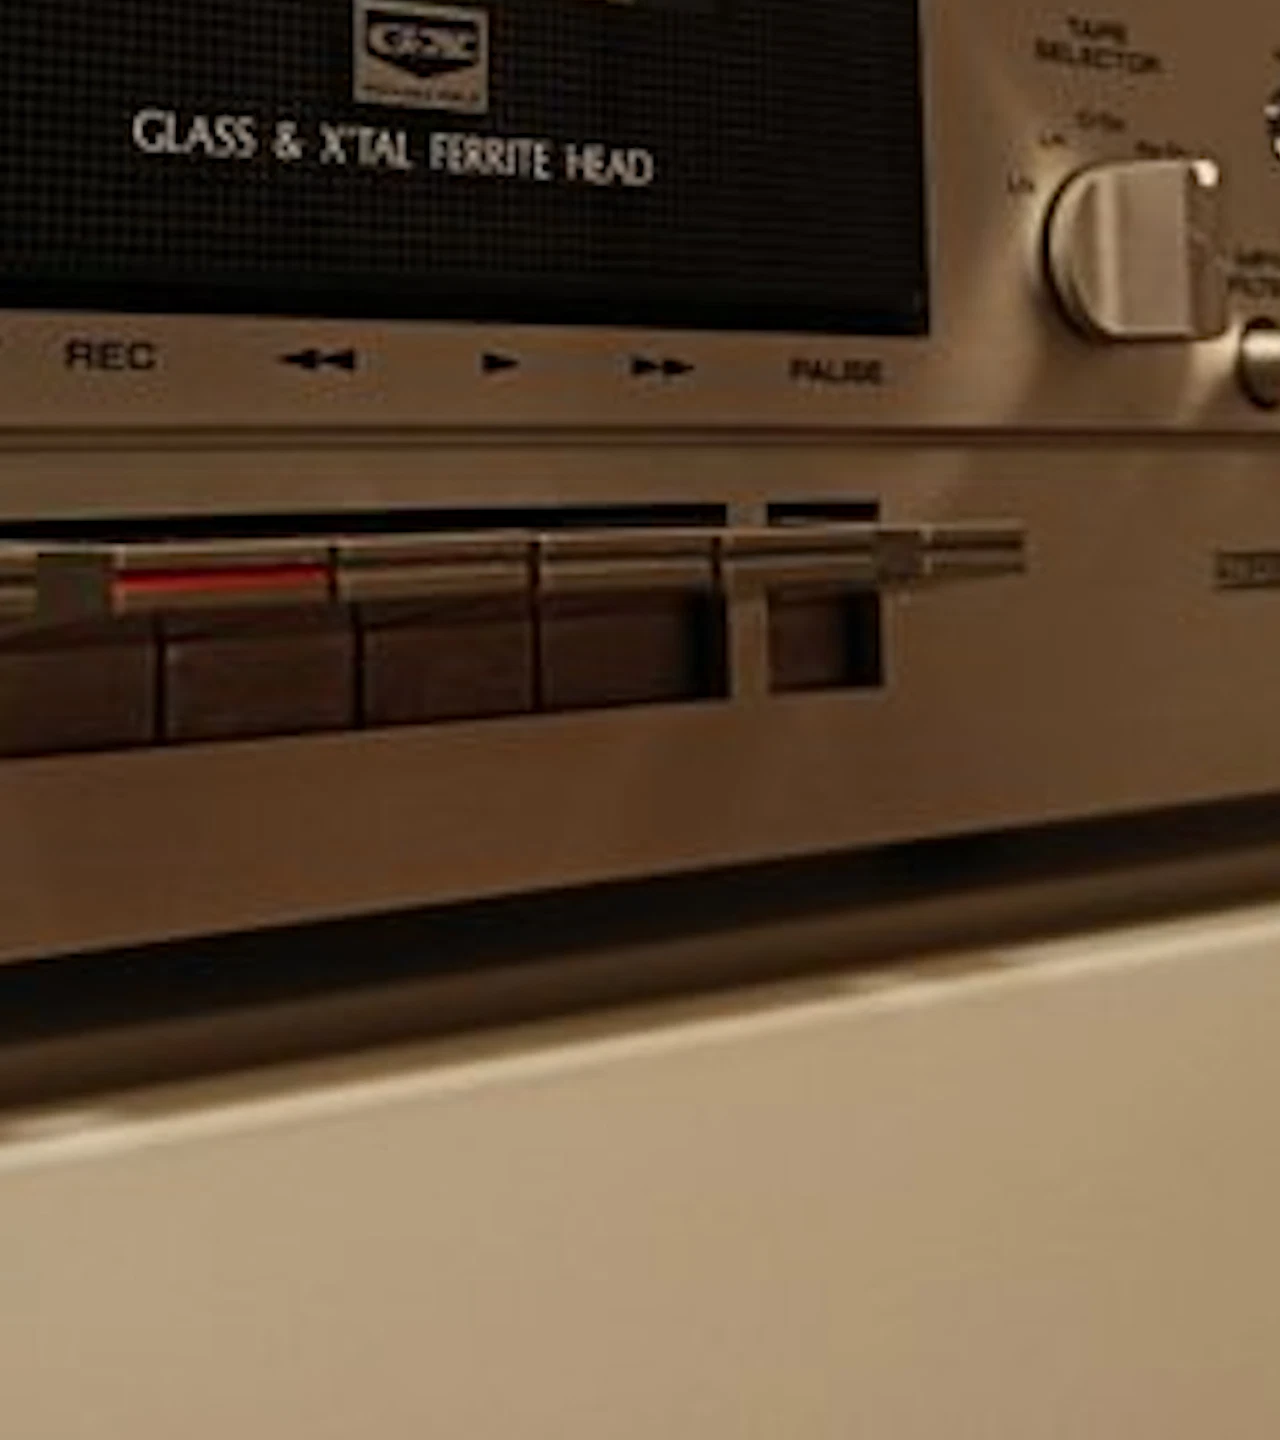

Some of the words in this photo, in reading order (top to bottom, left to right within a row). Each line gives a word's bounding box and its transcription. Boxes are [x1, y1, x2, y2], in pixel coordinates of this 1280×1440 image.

[131, 109, 256, 160] GLASS
[272, 121, 303, 159] &
[430, 134, 550, 180] FERRITE
[566, 146, 655, 187] HEAD
[64, 338, 158, 371] REC
[788, 358, 884, 386] PAUSE
